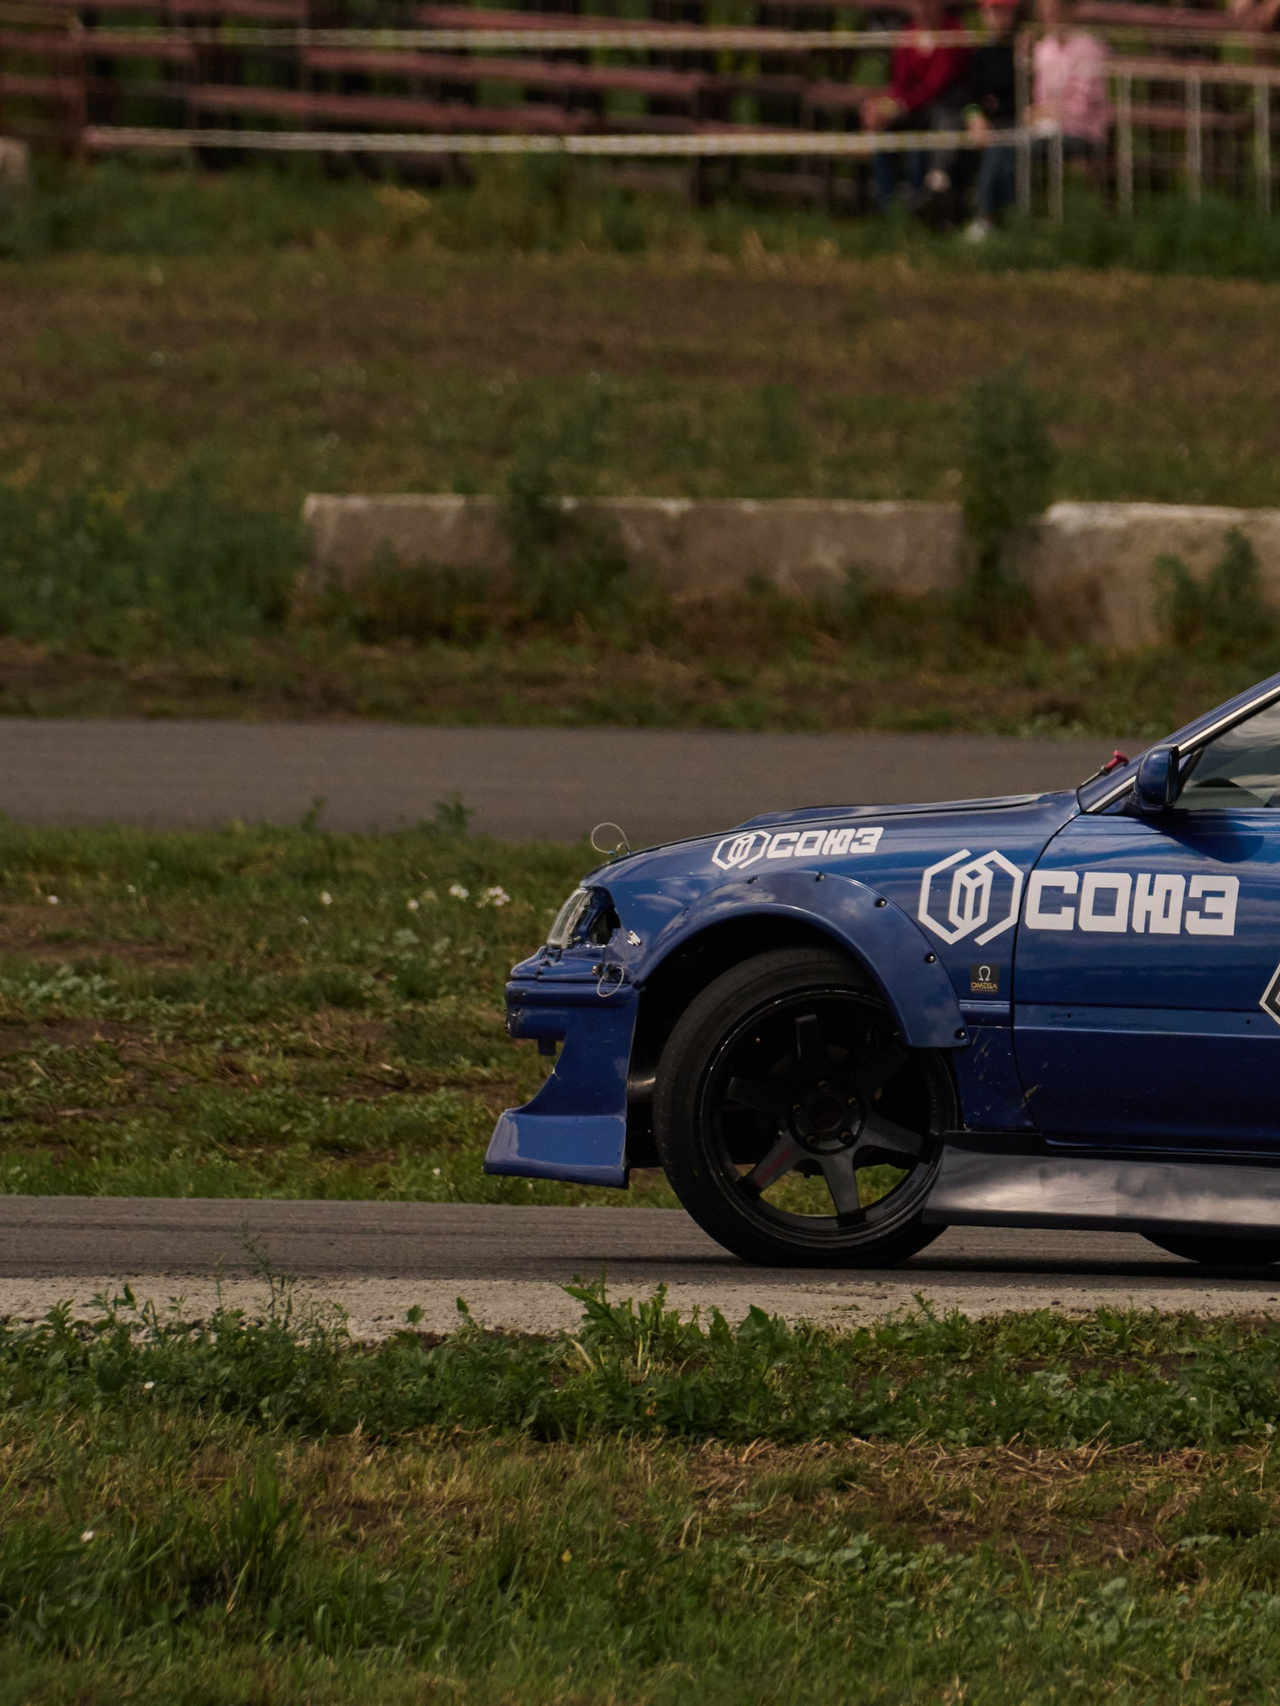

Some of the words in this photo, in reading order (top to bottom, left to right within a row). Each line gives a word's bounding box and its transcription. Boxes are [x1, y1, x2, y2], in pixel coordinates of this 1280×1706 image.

[766, 826, 884, 859] СОЮЗ
[1025, 869, 1240, 936] СОЮЗ
[970, 981, 998, 990] OMEGA
